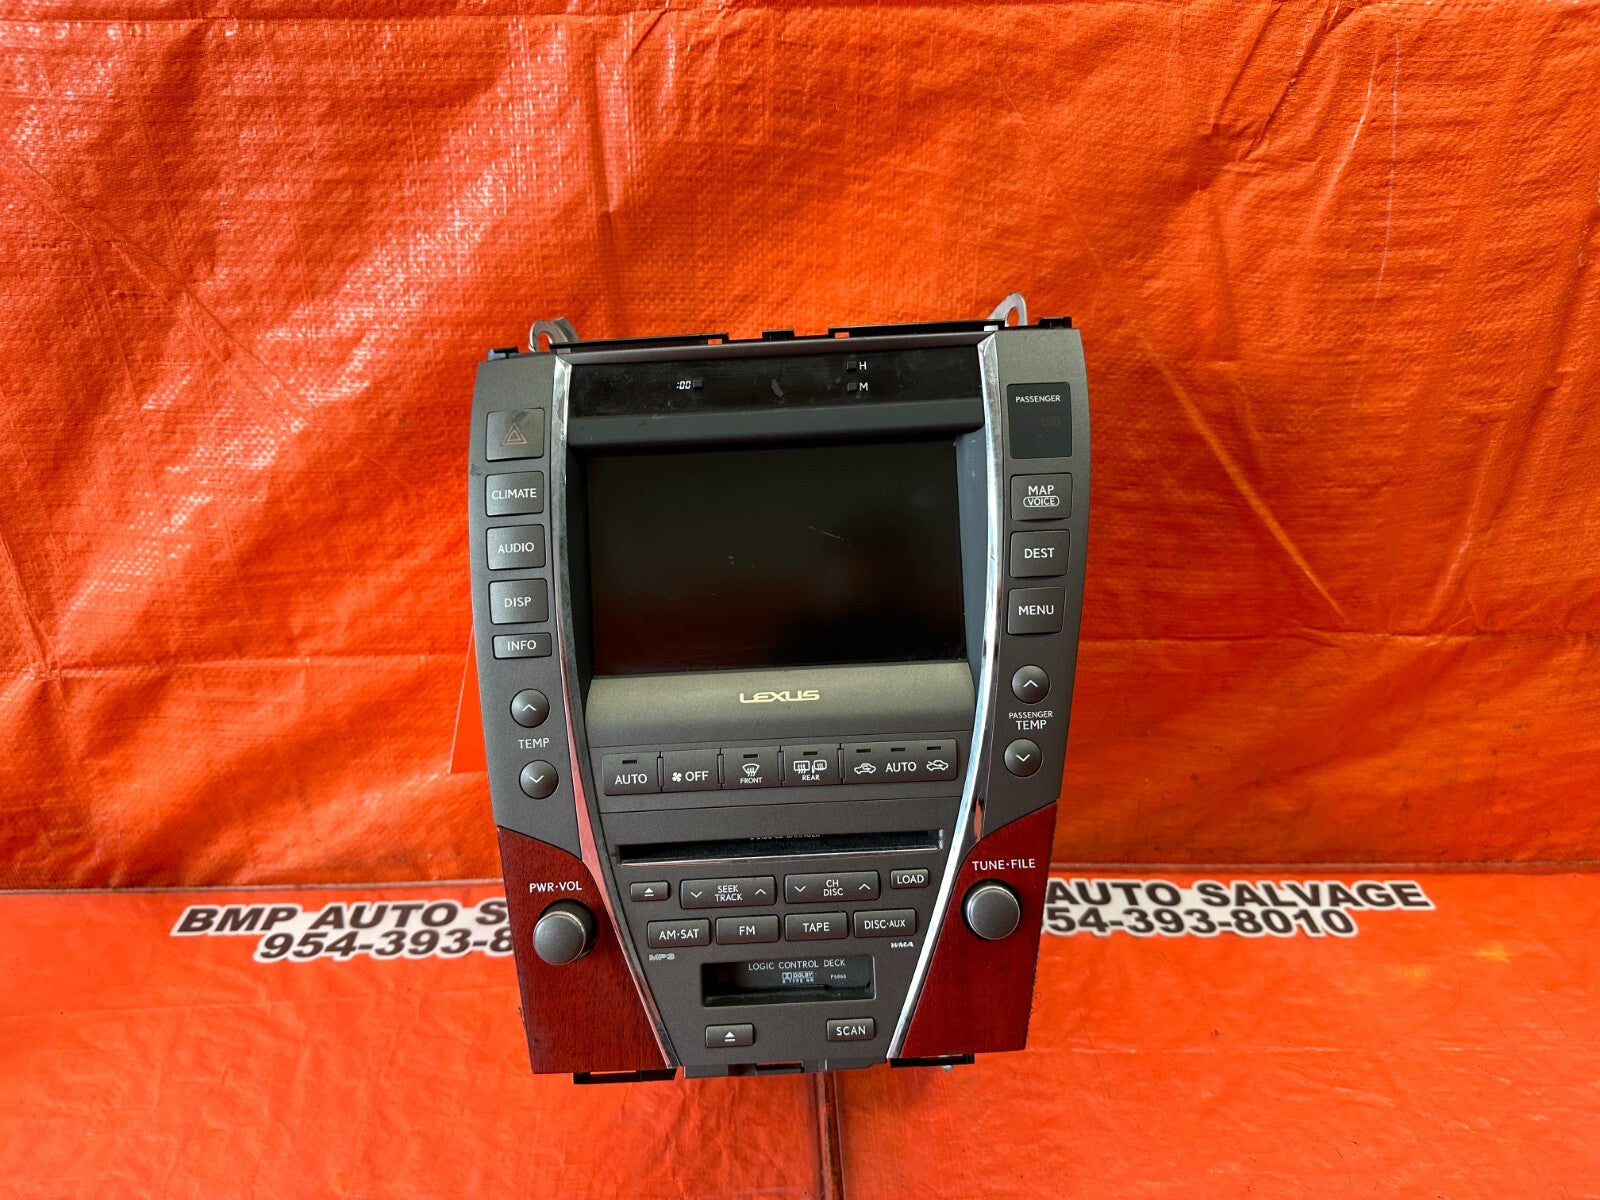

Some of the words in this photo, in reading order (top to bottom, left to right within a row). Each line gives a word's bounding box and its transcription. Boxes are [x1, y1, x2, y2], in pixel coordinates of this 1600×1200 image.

[859, 362, 867, 370] H
[676, 380, 691, 390] :00
[859, 382, 868, 391] M
[1015, 394, 1061, 403] PASSENGER
[491, 488, 537, 500] CLIMATE
[1028, 484, 1055, 496] MAP
[1027, 497, 1056, 506] VOICE
[498, 542, 535, 554] AUDIO
[1024, 548, 1054, 559] DEST
[504, 597, 532, 608] DISP
[1018, 604, 1054, 616] MENU
[507, 640, 537, 651] INFO
[739, 690, 820, 704] LEXUS
[1008, 710, 1053, 719] PASSENGER
[1015, 720, 1047, 730] TEMP
[517, 738, 550, 750] TEMP
[885, 761, 917, 773] AUTO
[614, 773, 648, 786] AUTO
[685, 770, 709, 782] OFF
[740, 776, 762, 784] FRONT
[801, 774, 820, 782] REAR
[826, 879, 840, 888] CH
[896, 874, 924, 885] LOAD
[717, 884, 738, 893] SEEK
[823, 888, 844, 896] DISC
[1045, 880, 1183, 906] AUTO
[1198, 882, 1432, 908] SALVAGE
[714, 892, 743, 902] TRACK
[177, 906, 299, 933] BMP
[308, 902, 458, 930] AUTO
[475, 900, 510, 926] S
[1042, 905, 1354, 934] 54-393-8010
[738, 925, 756, 936] FM
[802, 922, 830, 932] TAPE
[649, 952, 675, 961] MP3
[748, 962, 774, 971] LOGIC
[778, 960, 818, 970] CONTROL
[824, 958, 846, 967] DECK
[836, 1026, 866, 1036] SCAN
